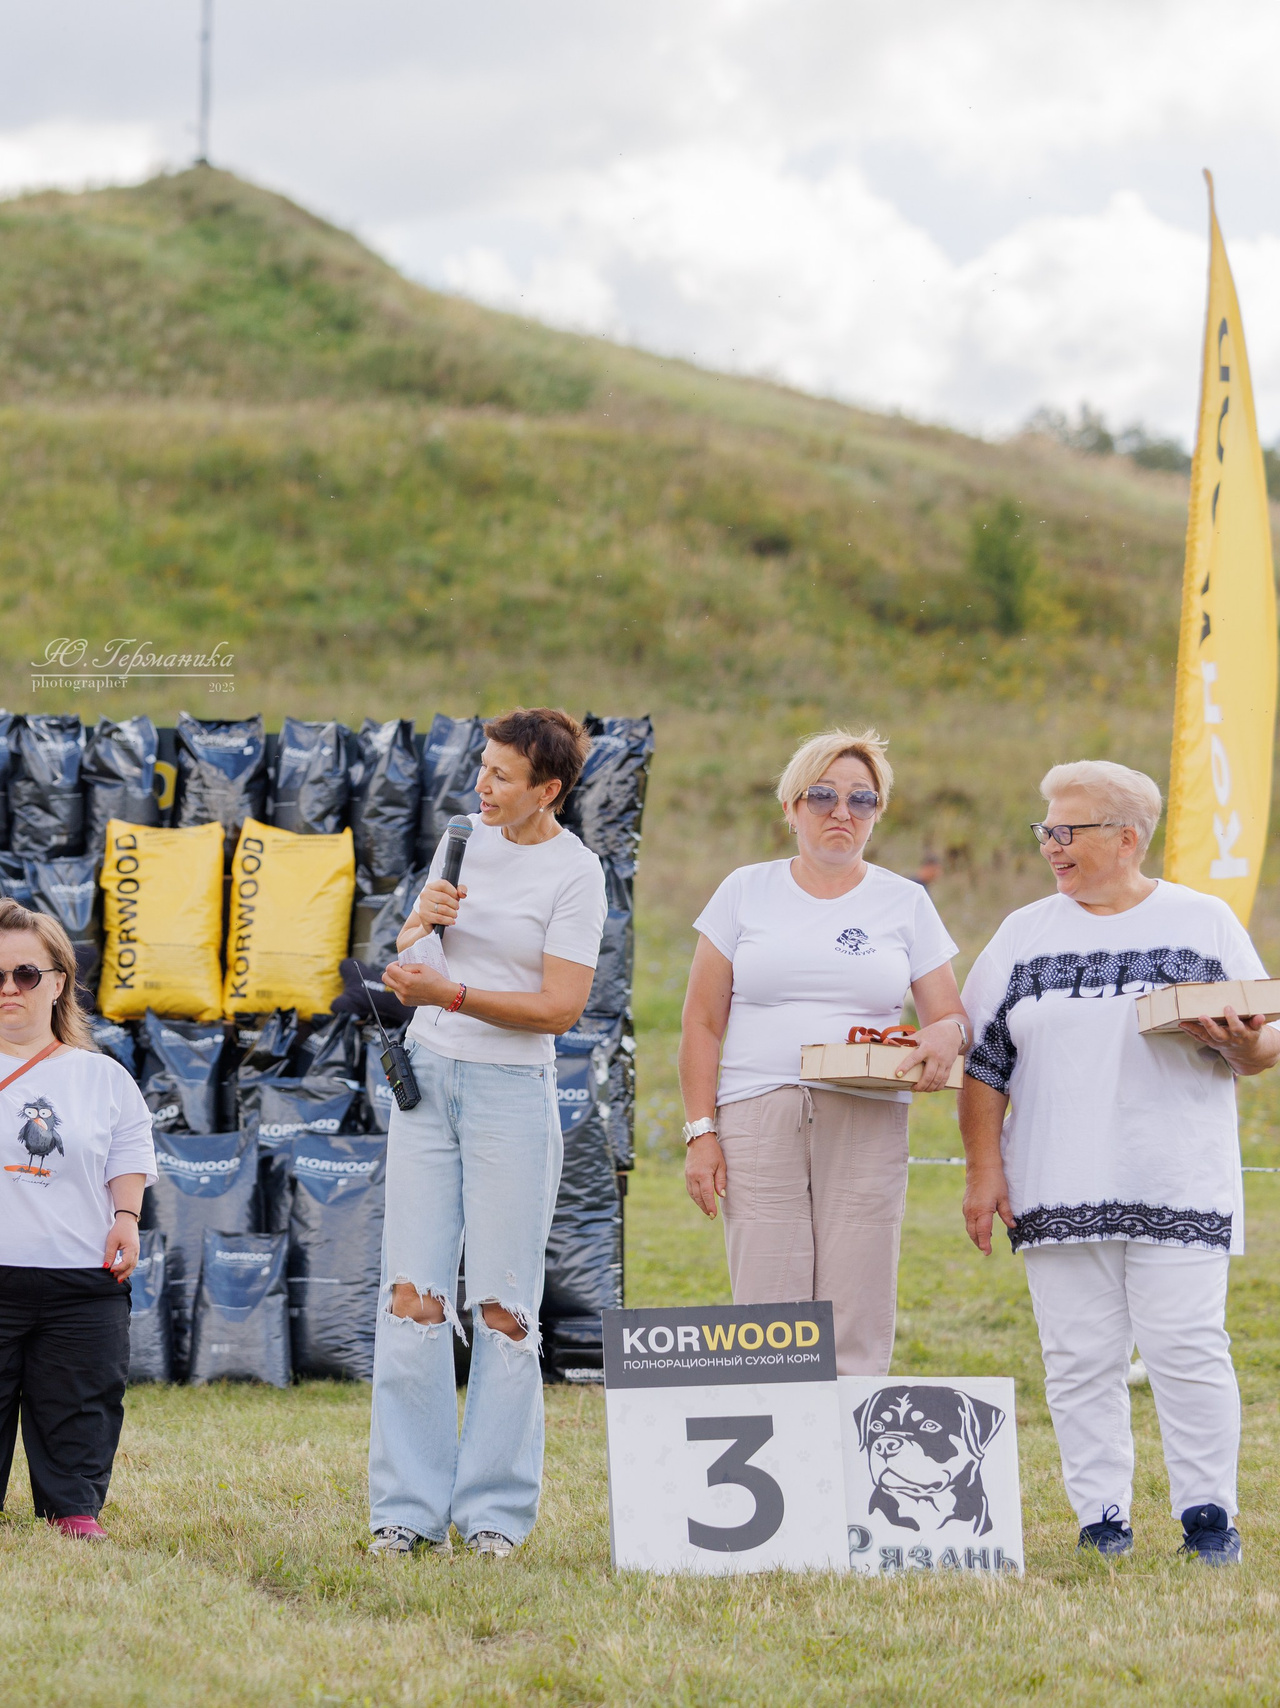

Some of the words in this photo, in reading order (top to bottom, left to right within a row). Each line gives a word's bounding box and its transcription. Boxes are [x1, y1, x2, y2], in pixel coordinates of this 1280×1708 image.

[114, 834, 140, 990] KORWOOD
[230, 837, 264, 999] KORWOOD
[156, 1151, 241, 1173] KORWOOD
[622, 1320, 820, 1354] KORWOOD
[623, 1354, 743, 1370] ПОЛНОРАЦИОННЫЙ
[745, 1352, 784, 1365] СУХОЙ
[787, 1353, 820, 1364] КОРМ
[685, 1414, 786, 1552] 3
